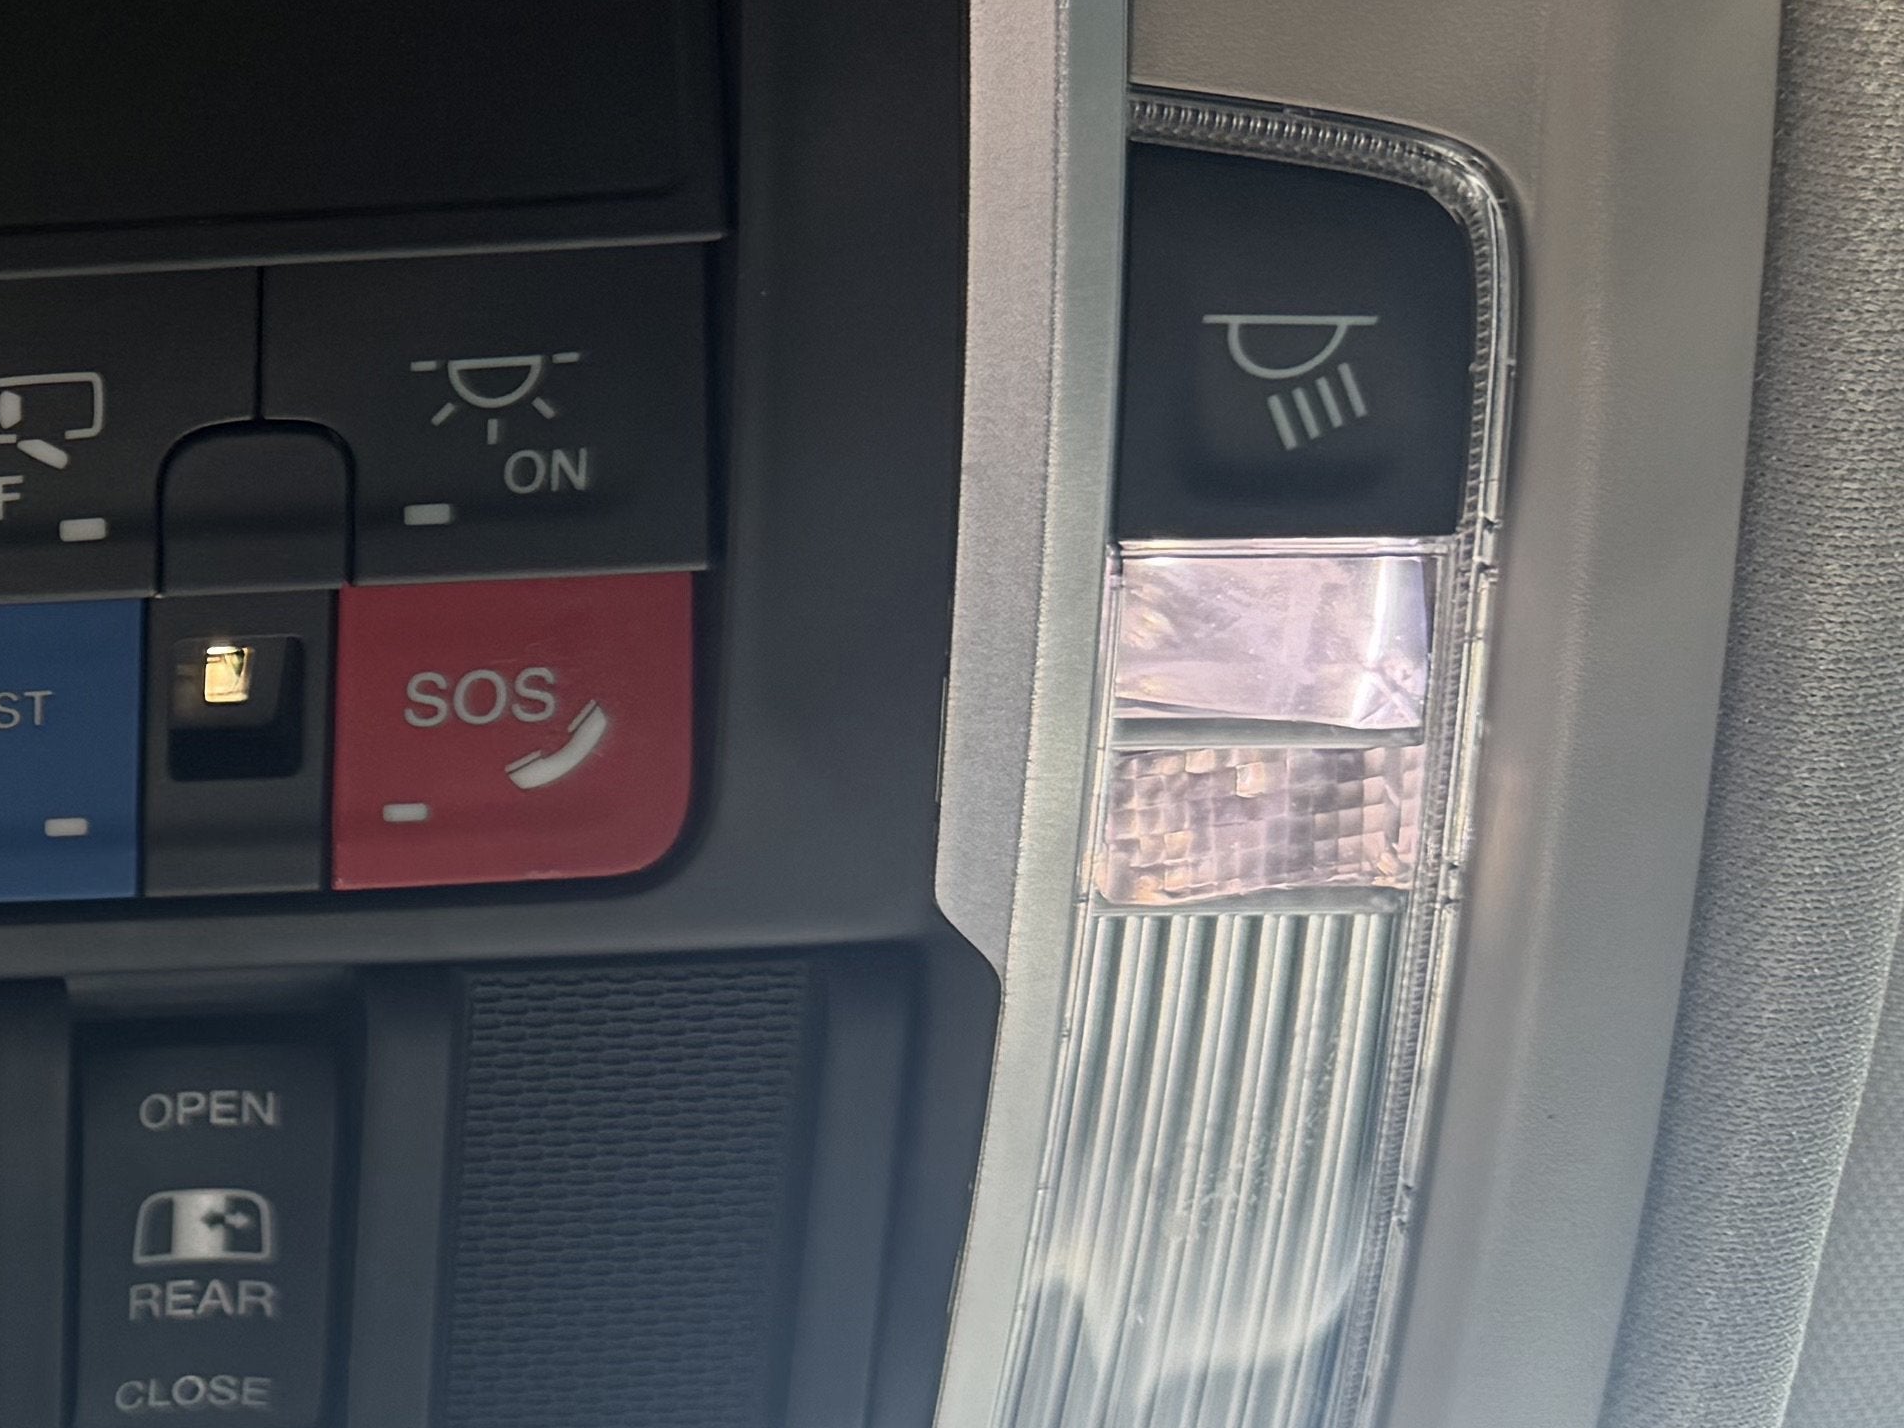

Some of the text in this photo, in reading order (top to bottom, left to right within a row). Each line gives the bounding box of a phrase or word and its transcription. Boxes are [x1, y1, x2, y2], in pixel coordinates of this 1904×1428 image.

[502, 447, 589, 494] ON
[404, 666, 557, 728] SOS
[138, 1089, 279, 1131] OPEN
[129, 1278, 276, 1321] REAR
[114, 1374, 272, 1412] CLOSE
